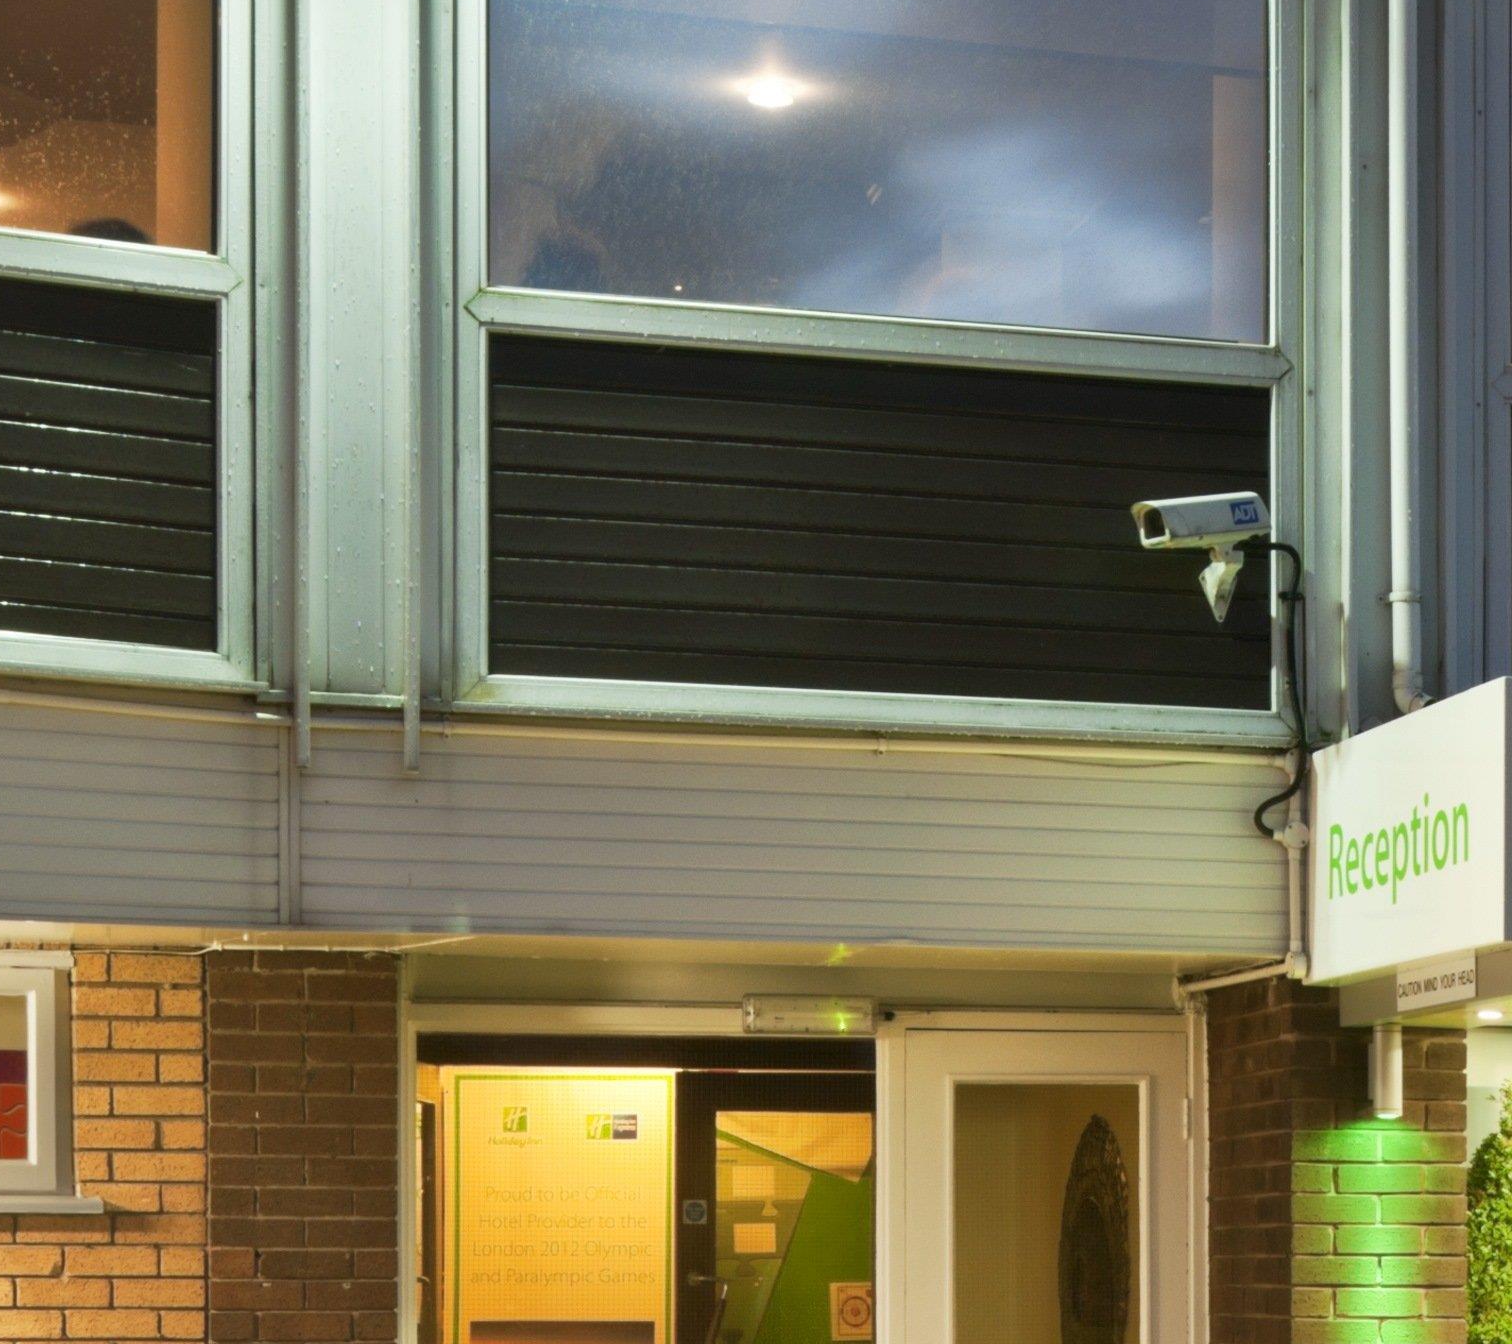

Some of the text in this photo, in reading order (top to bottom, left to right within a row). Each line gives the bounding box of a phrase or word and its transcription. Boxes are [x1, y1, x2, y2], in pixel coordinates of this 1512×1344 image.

[1234, 504, 1256, 522] ADT
[1327, 792, 1470, 904] Reception
[1397, 969, 1475, 998] CAUTION MIND YOUR HEAD
[485, 1186, 641, 1202] Proud to be Official
[478, 1213, 648, 1230] Hotel Provider to the
[472, 1240, 652, 1261] London 2012 Olympic
[469, 1268, 656, 1288] and Paralympic Games
